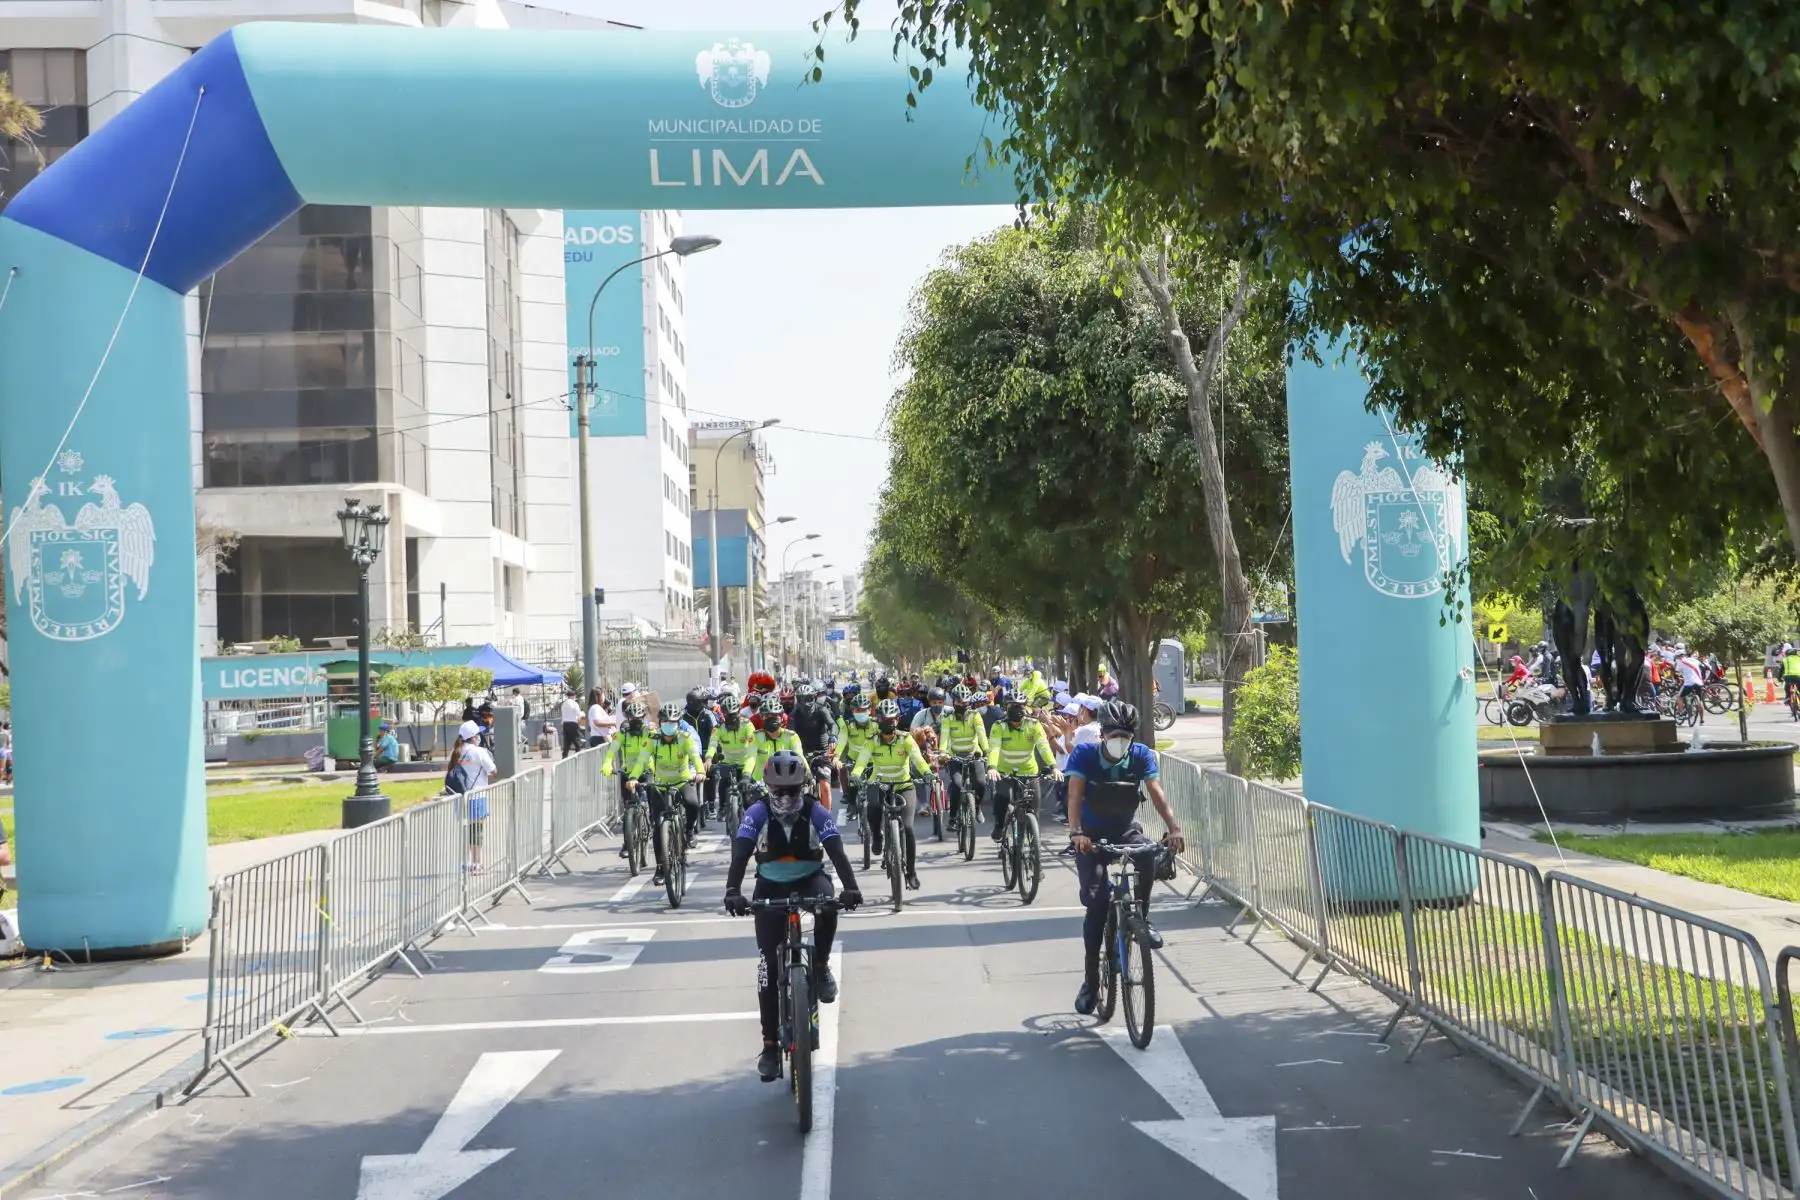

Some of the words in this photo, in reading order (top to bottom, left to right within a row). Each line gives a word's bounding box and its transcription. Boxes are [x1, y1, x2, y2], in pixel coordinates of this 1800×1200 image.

[649, 119, 793, 133] MUNICIPALIDAD
[798, 119, 822, 133] DE
[650, 149, 825, 186] LIMA
[565, 225, 634, 245] ADOS
[59, 481, 84, 497] IK
